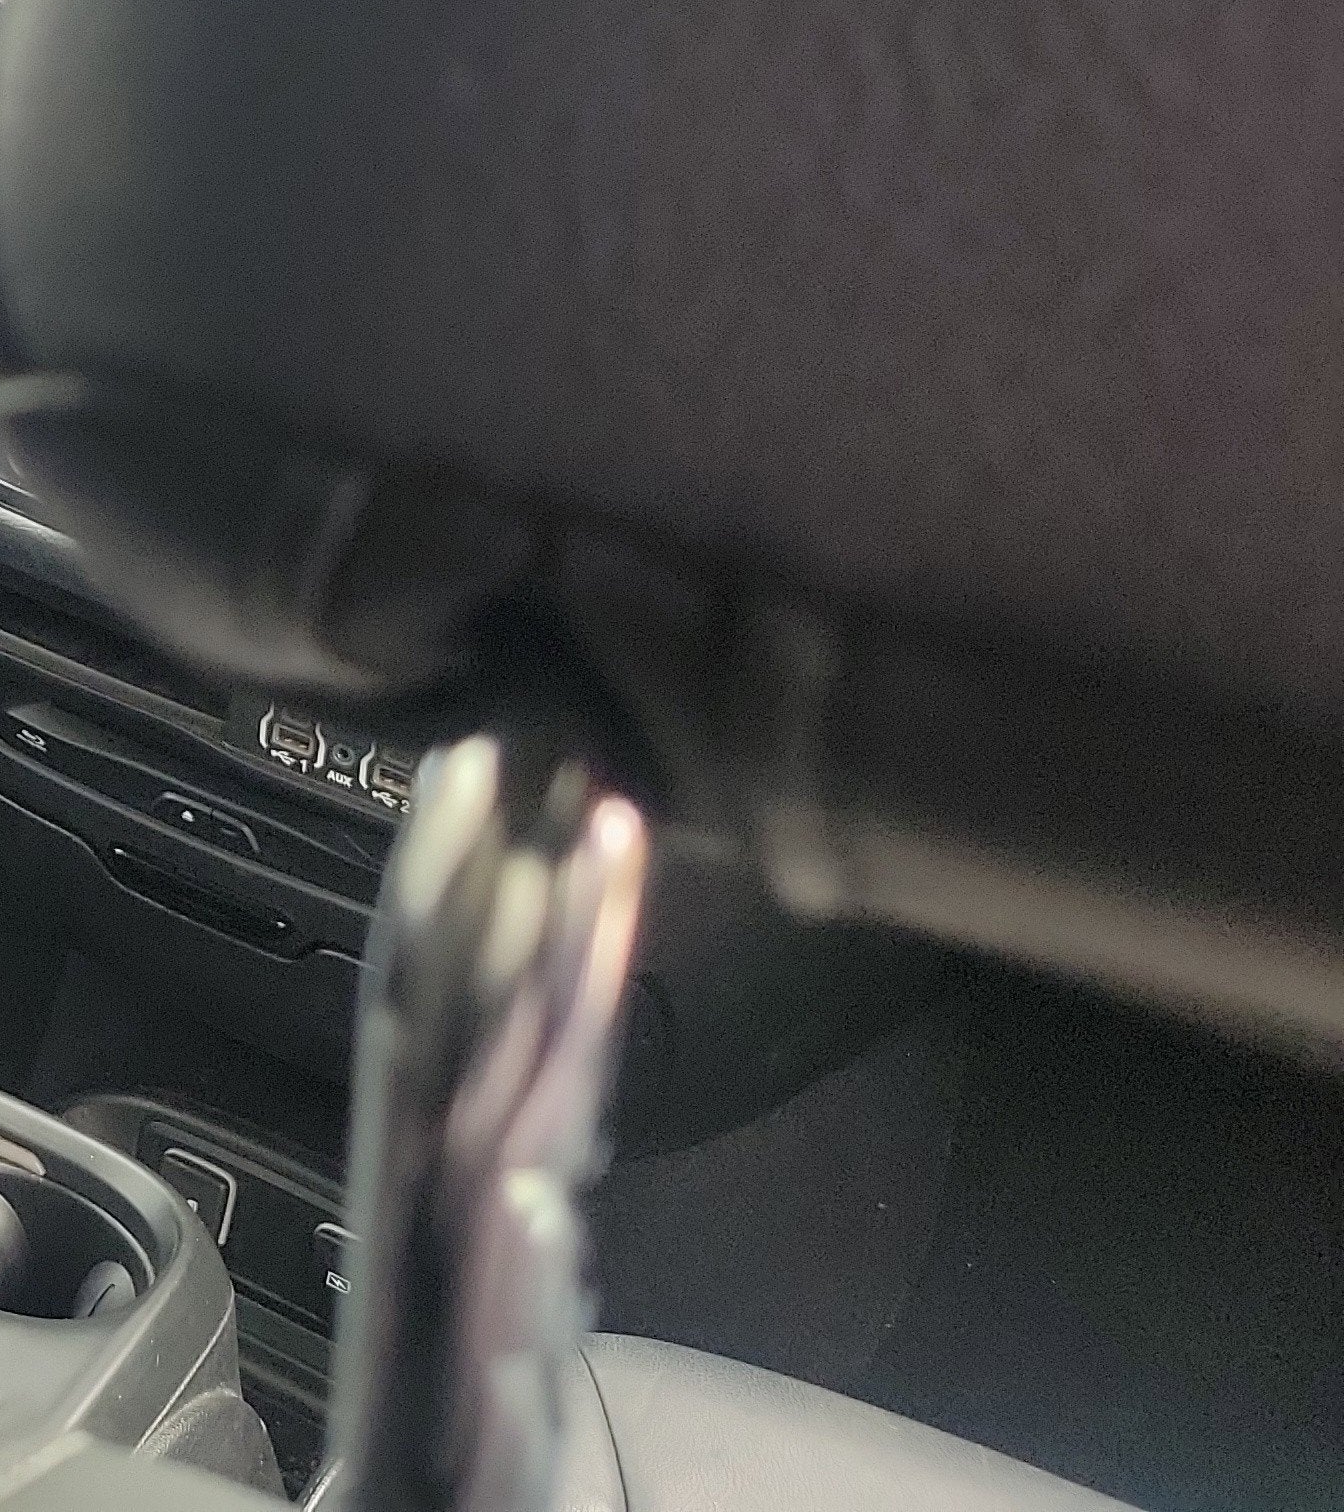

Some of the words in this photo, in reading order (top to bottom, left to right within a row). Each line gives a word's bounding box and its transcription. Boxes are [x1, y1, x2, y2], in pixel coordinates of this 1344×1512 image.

[300, 759, 308, 774] 1
[326, 769, 354, 789] AUX
[399, 799, 410, 814] 2
